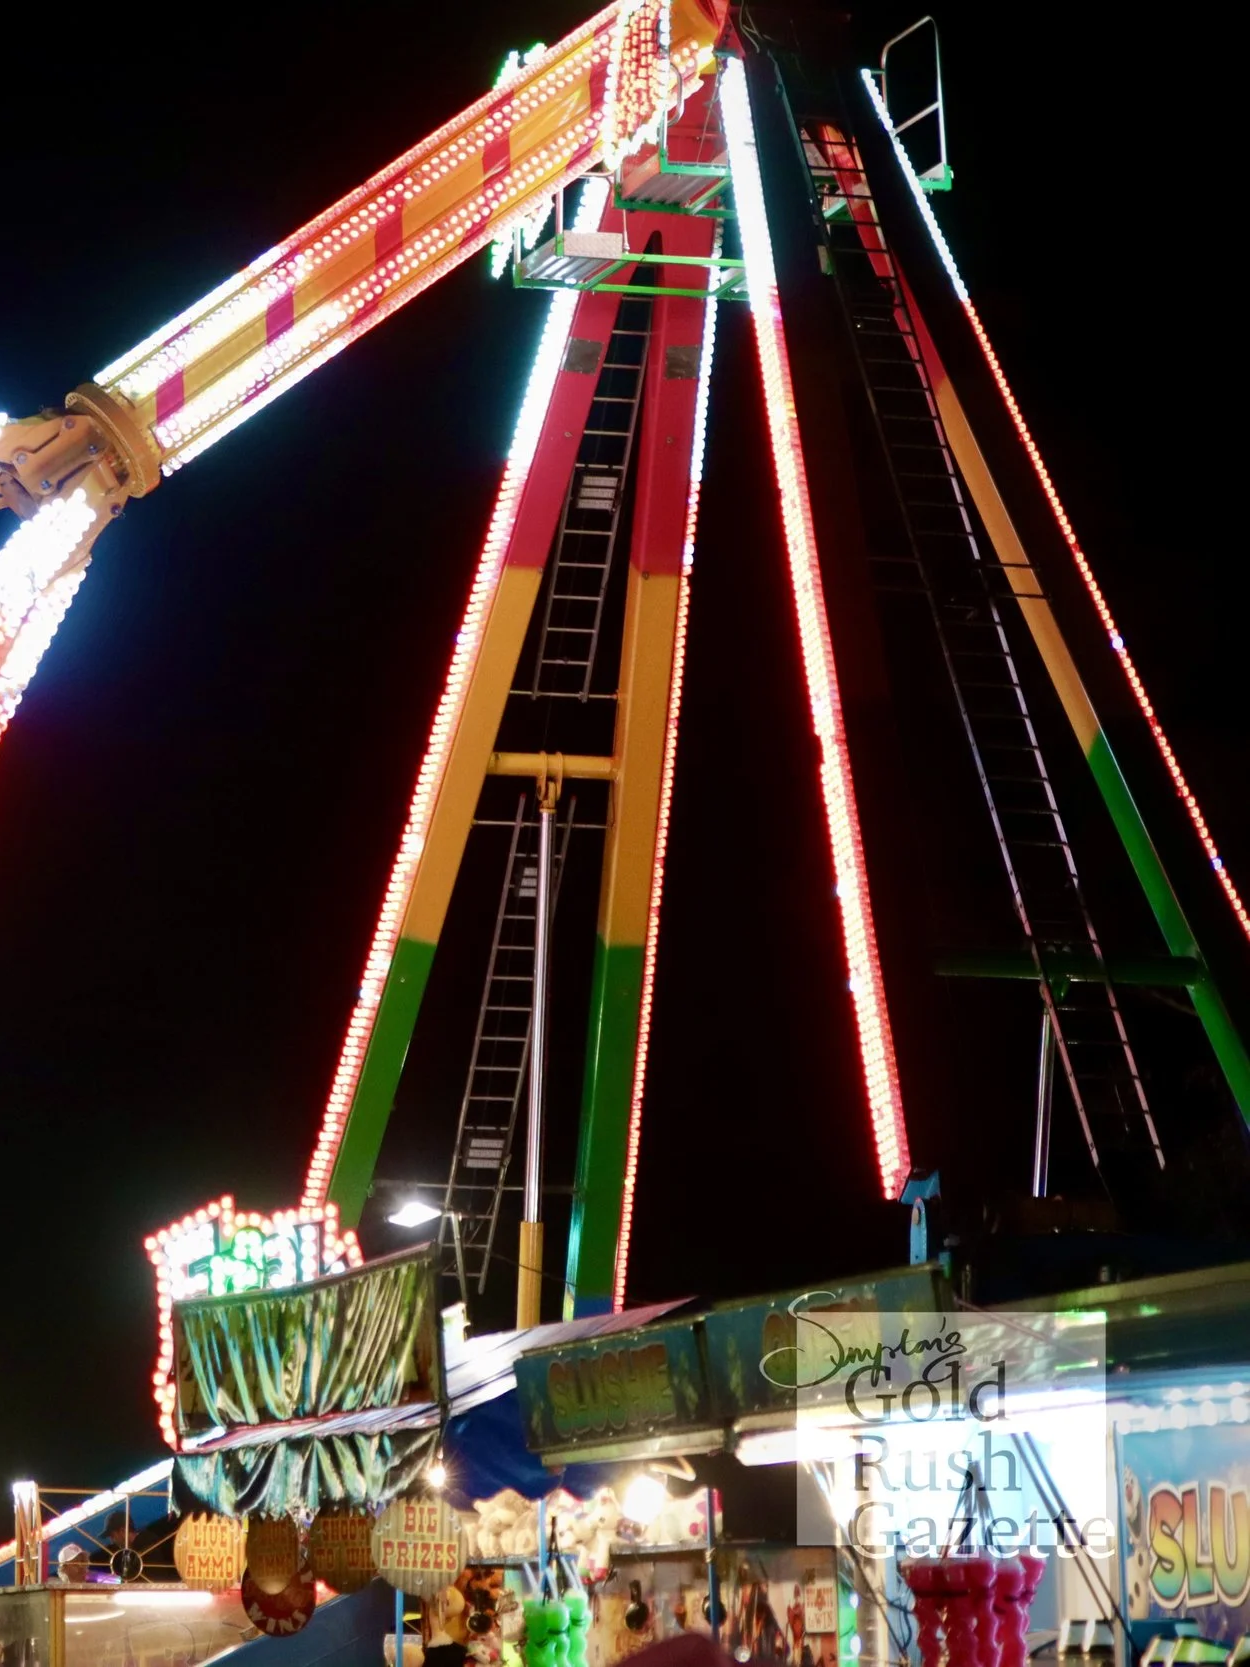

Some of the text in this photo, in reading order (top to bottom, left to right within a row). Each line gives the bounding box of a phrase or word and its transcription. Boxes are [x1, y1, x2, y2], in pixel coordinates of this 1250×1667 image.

[322, 1517, 367, 1542] SHOOT
[403, 1505, 438, 1534] BIG
[192, 1524, 229, 1549] LIVE
[185, 1554, 235, 1581] AMMO
[315, 1548, 336, 1571] TO
[381, 1541, 459, 1572] PRIZES
